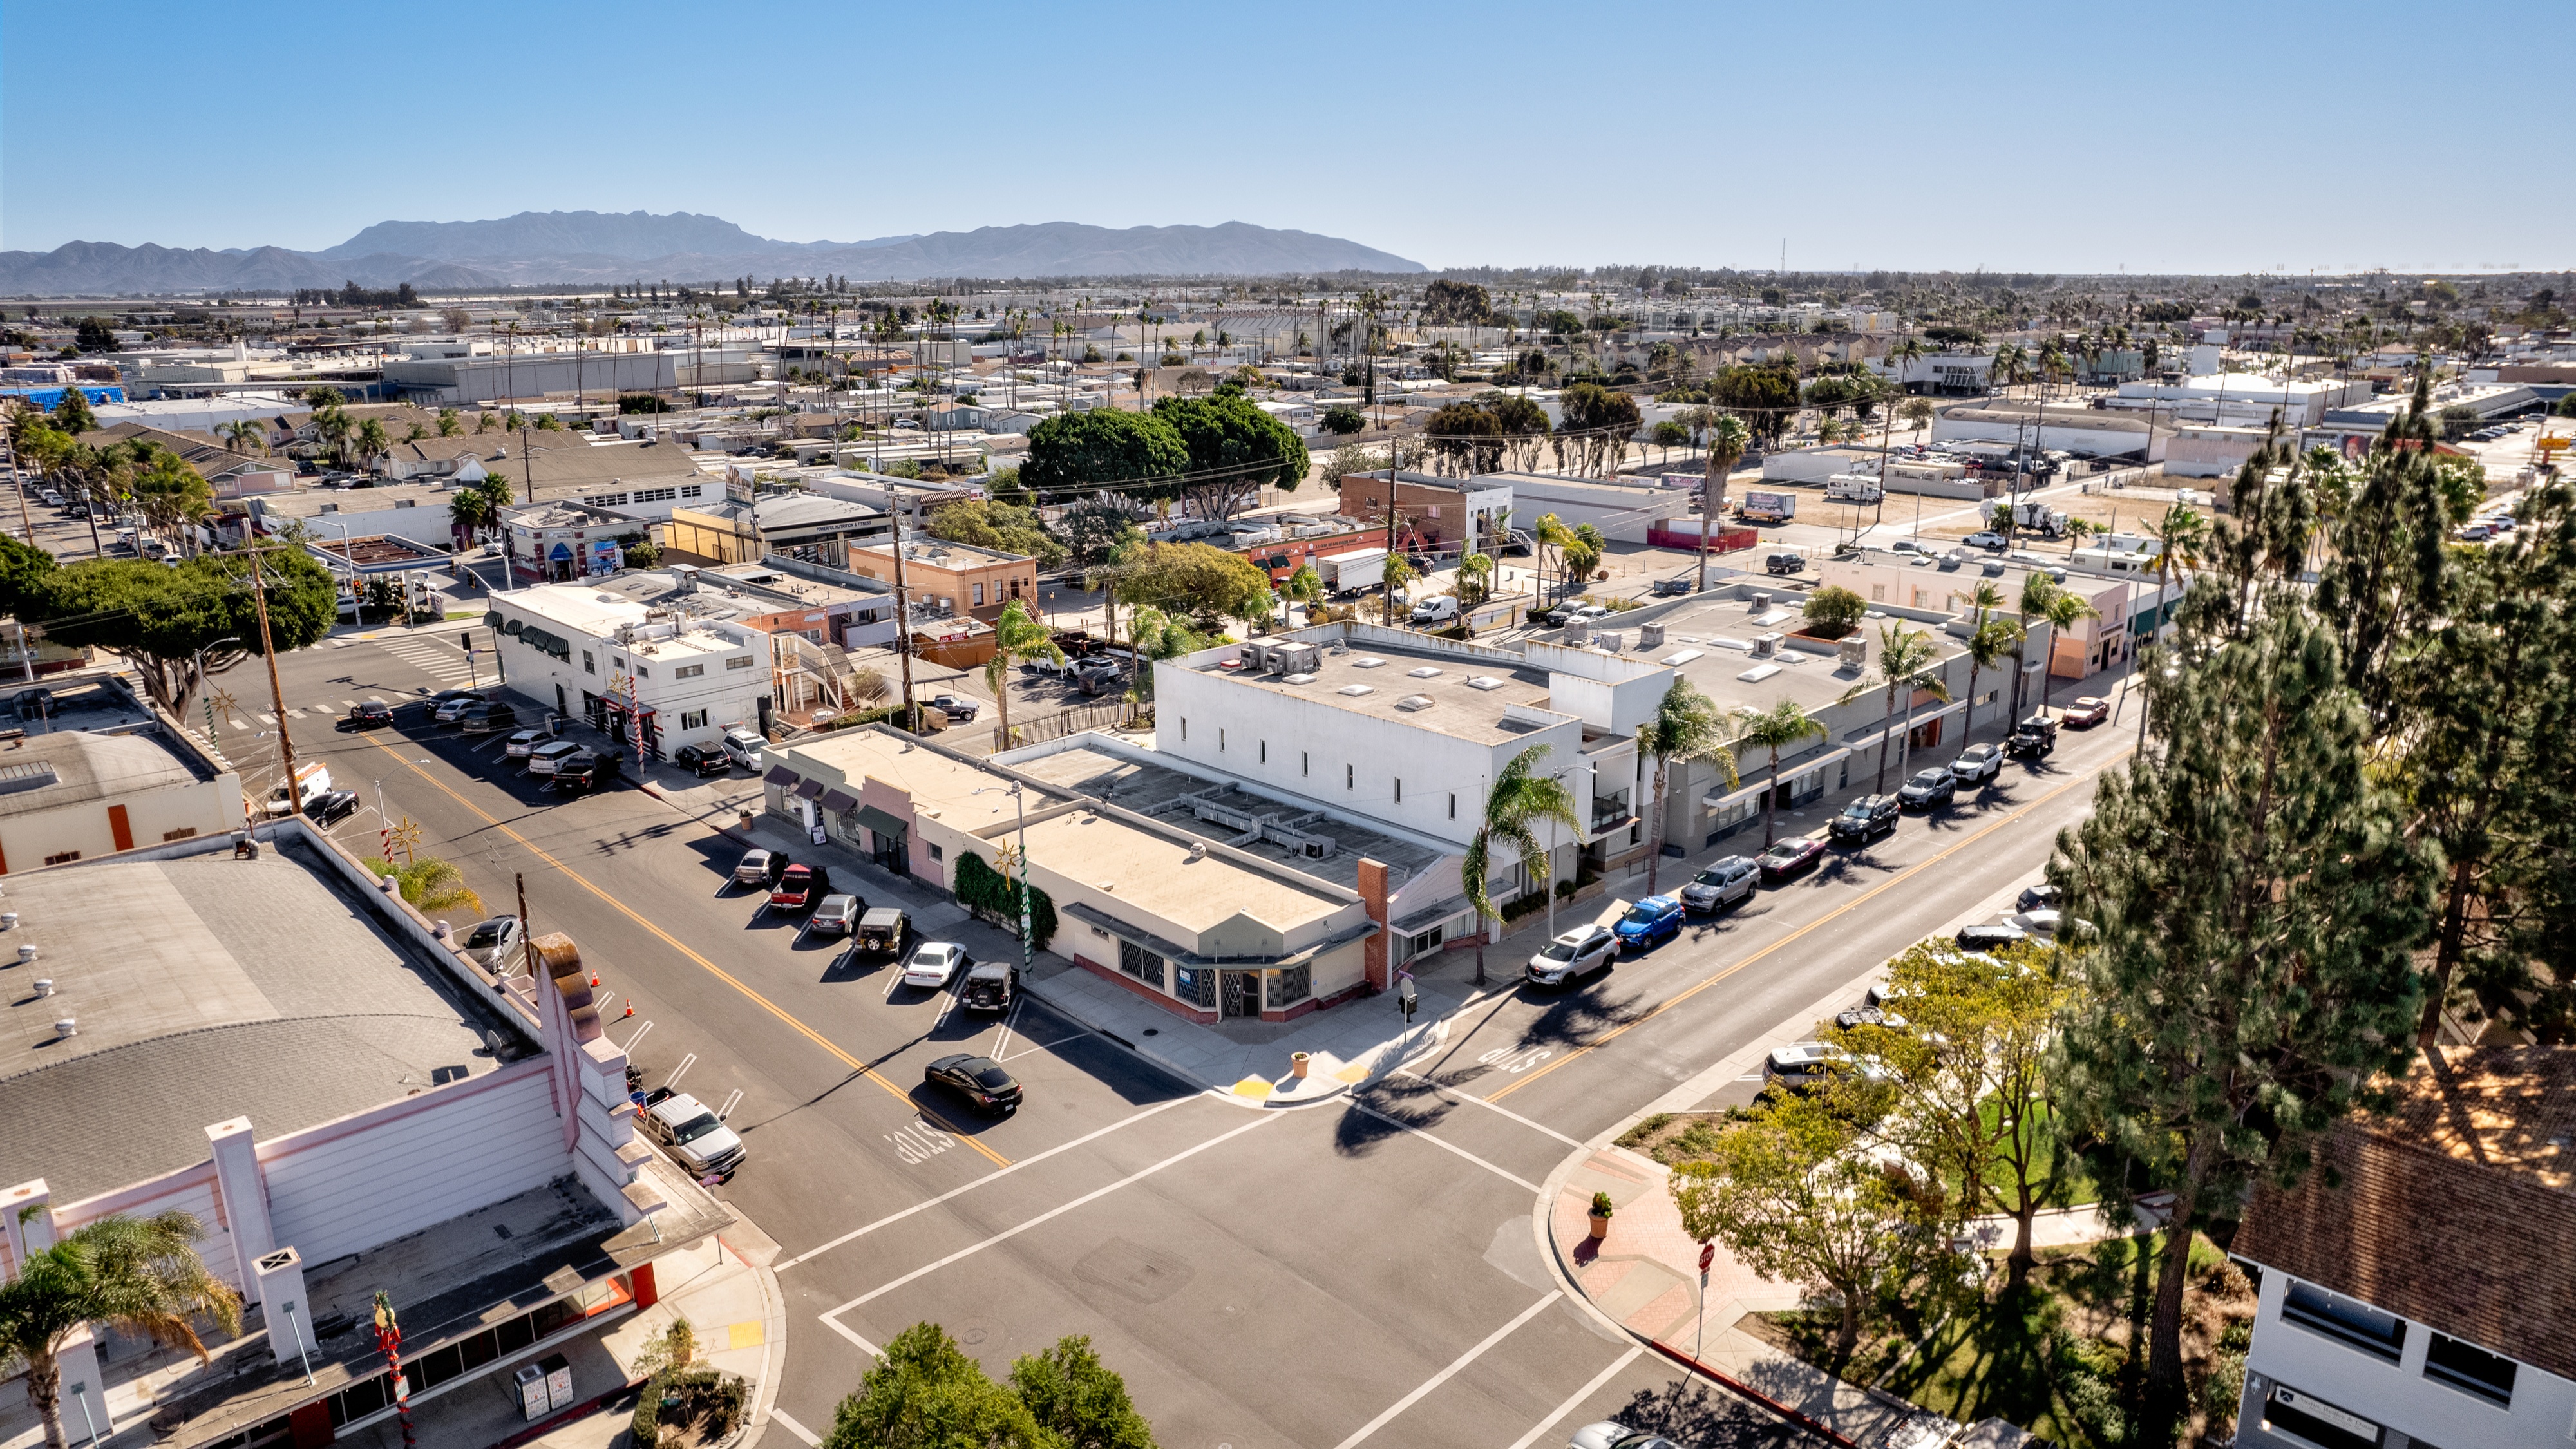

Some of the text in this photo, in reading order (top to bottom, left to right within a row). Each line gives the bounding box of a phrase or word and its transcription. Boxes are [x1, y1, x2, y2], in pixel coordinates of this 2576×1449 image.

[1477, 1041, 1552, 1074] STOP
[883, 1121, 955, 1164] STOP
[1700, 1249, 1714, 1265] STOP
